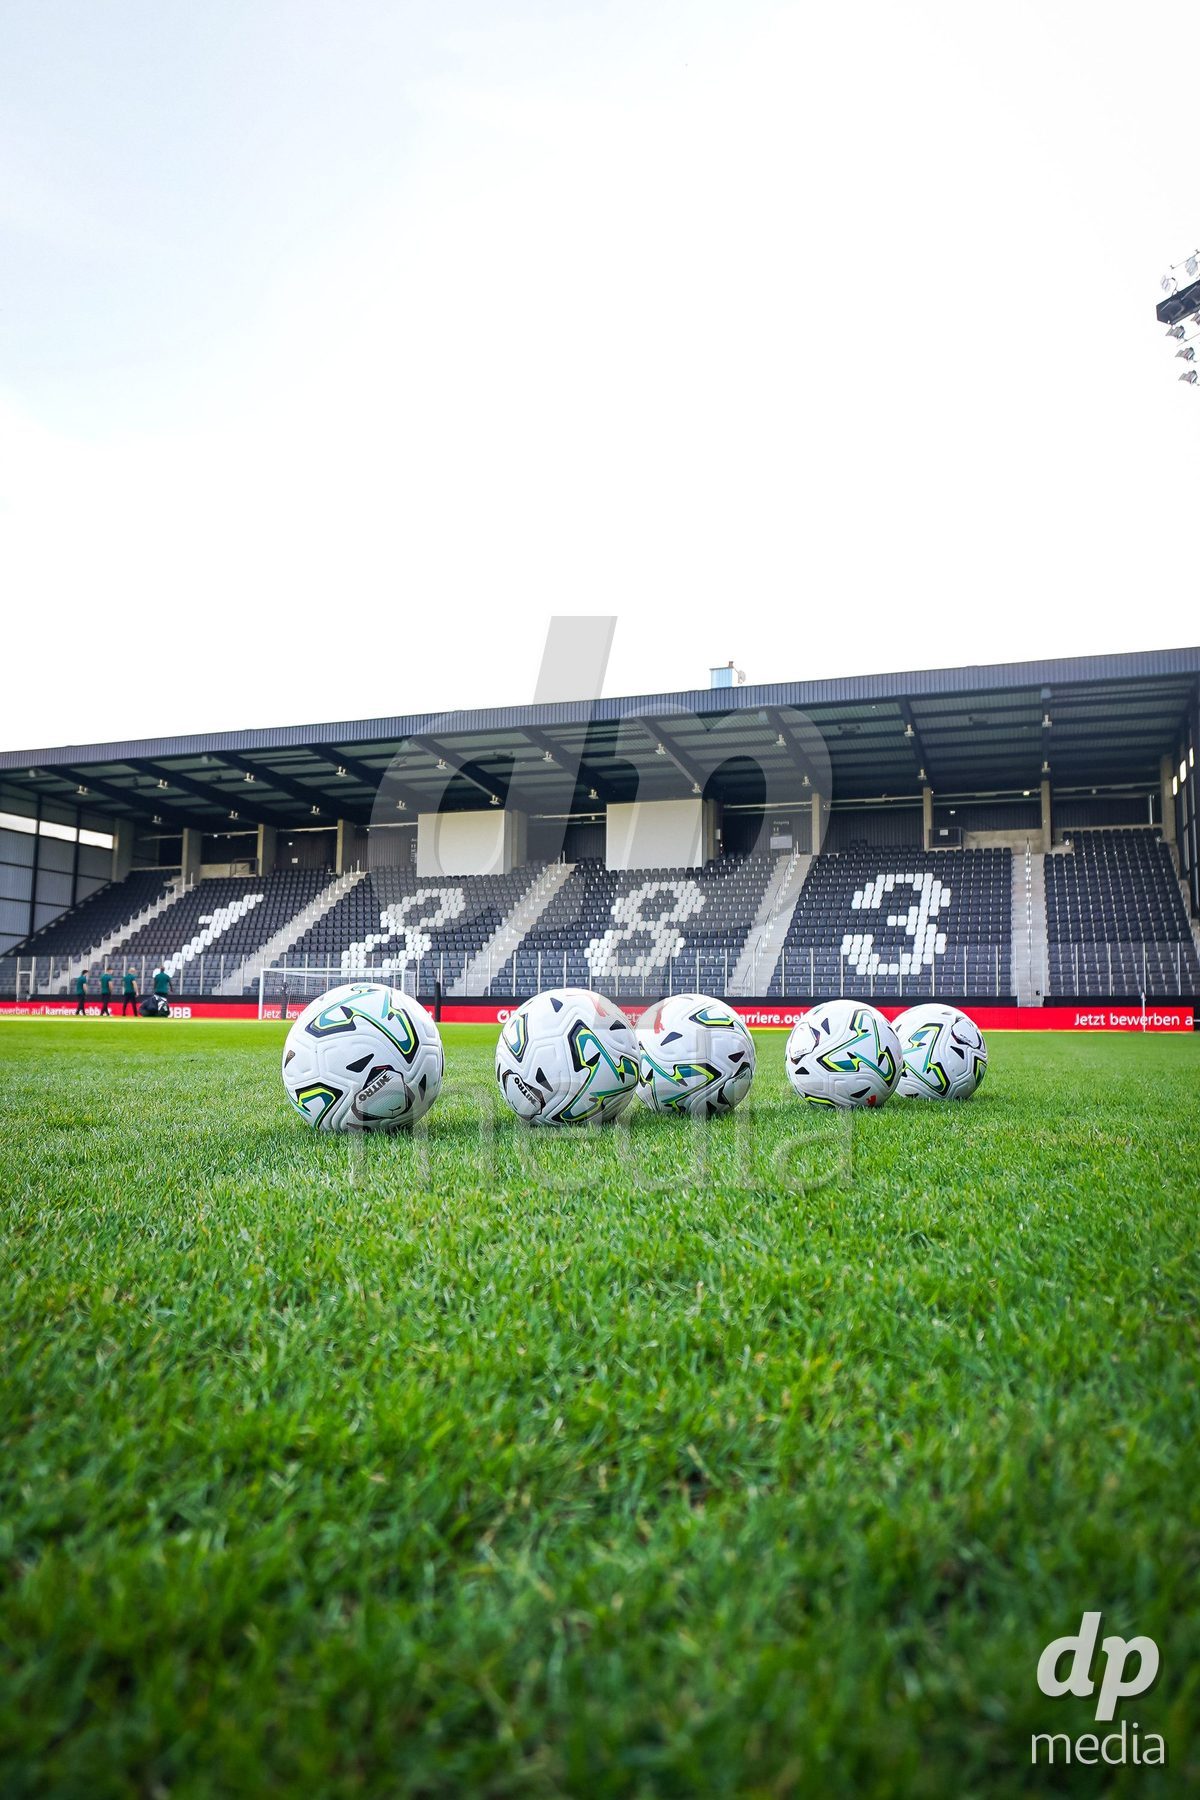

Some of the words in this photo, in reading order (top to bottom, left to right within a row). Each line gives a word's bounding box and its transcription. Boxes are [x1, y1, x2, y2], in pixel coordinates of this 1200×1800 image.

[263, 1009, 283, 1019] Jetz
[1074, 1013, 1106, 1026] Jetzt
[1109, 1012, 1180, 1026] bewerben
[358, 1072, 394, 1102] NITRO
